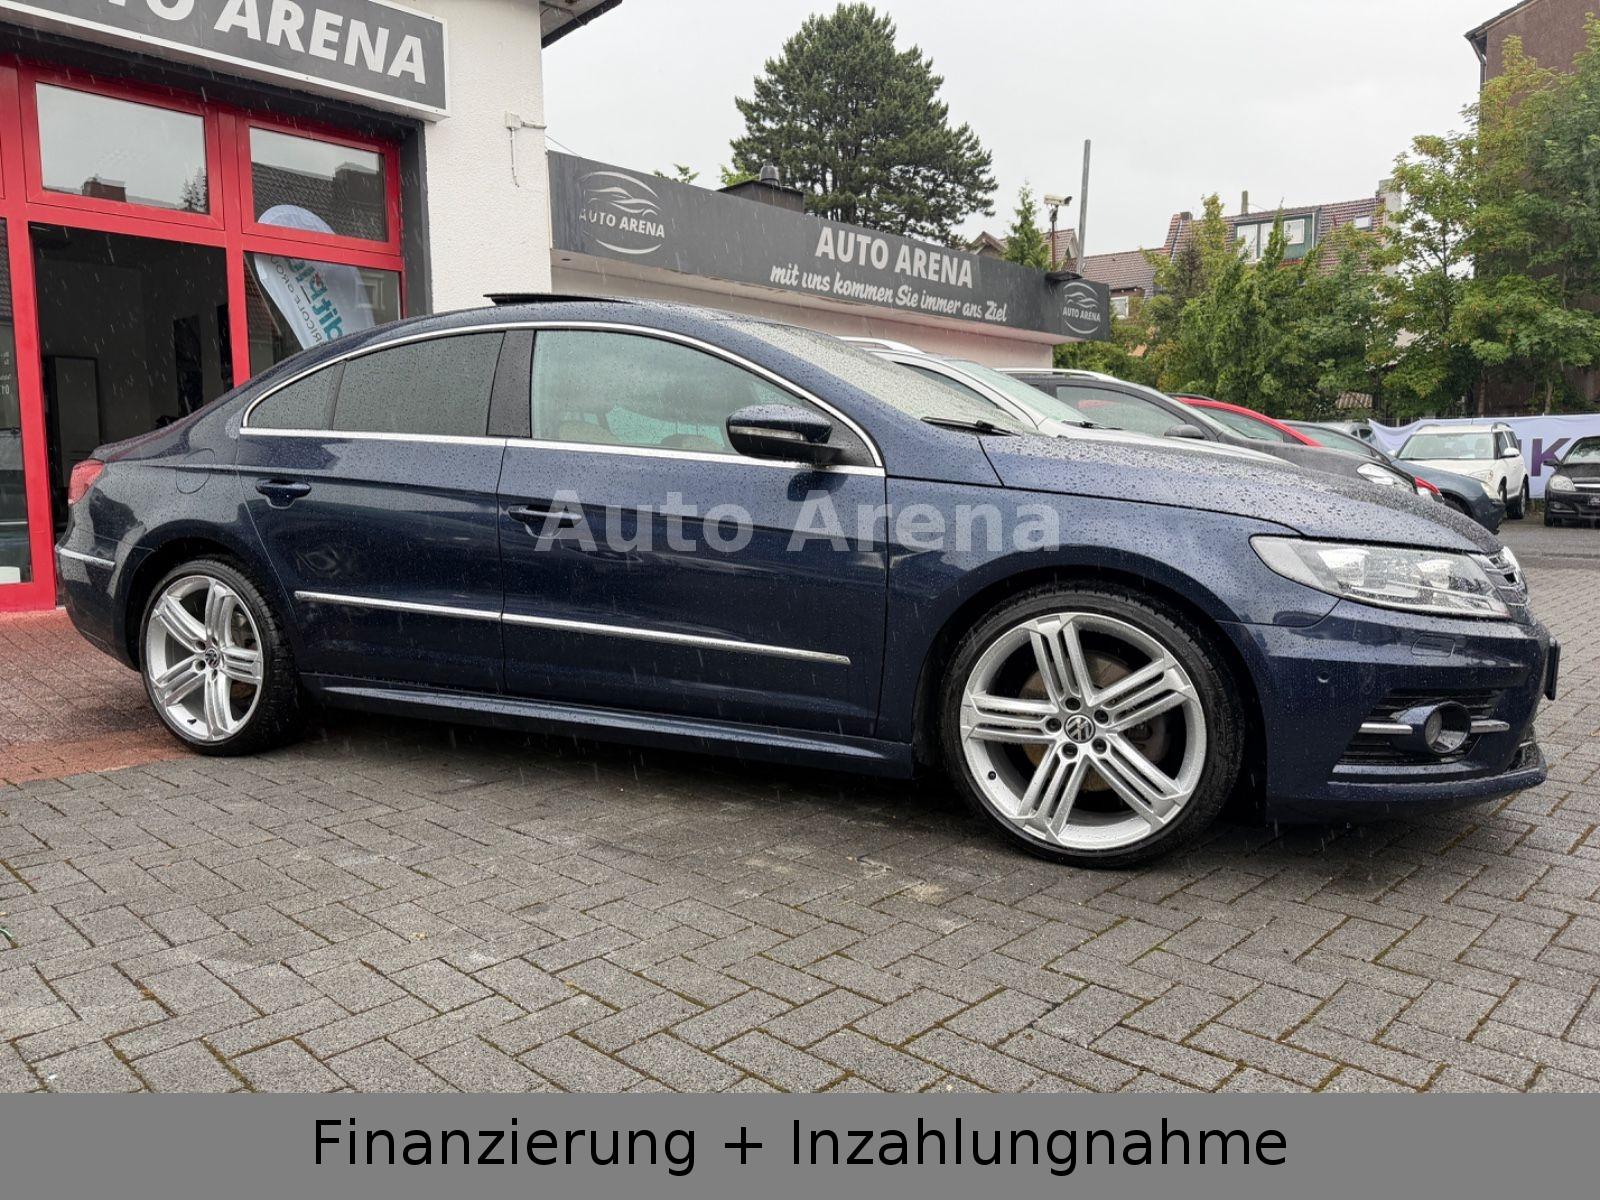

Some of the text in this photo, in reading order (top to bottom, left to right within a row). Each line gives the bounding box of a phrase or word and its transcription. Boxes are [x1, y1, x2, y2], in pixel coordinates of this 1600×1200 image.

[213, 0, 428, 86] ARENA
[579, 208, 665, 238] AUTO ARENA
[815, 226, 973, 289] AUTO ARENA
[770, 262, 1007, 322] mit uns kommen Sie immer ans Ziel
[1062, 306, 1101, 322] AUTO ARENA
